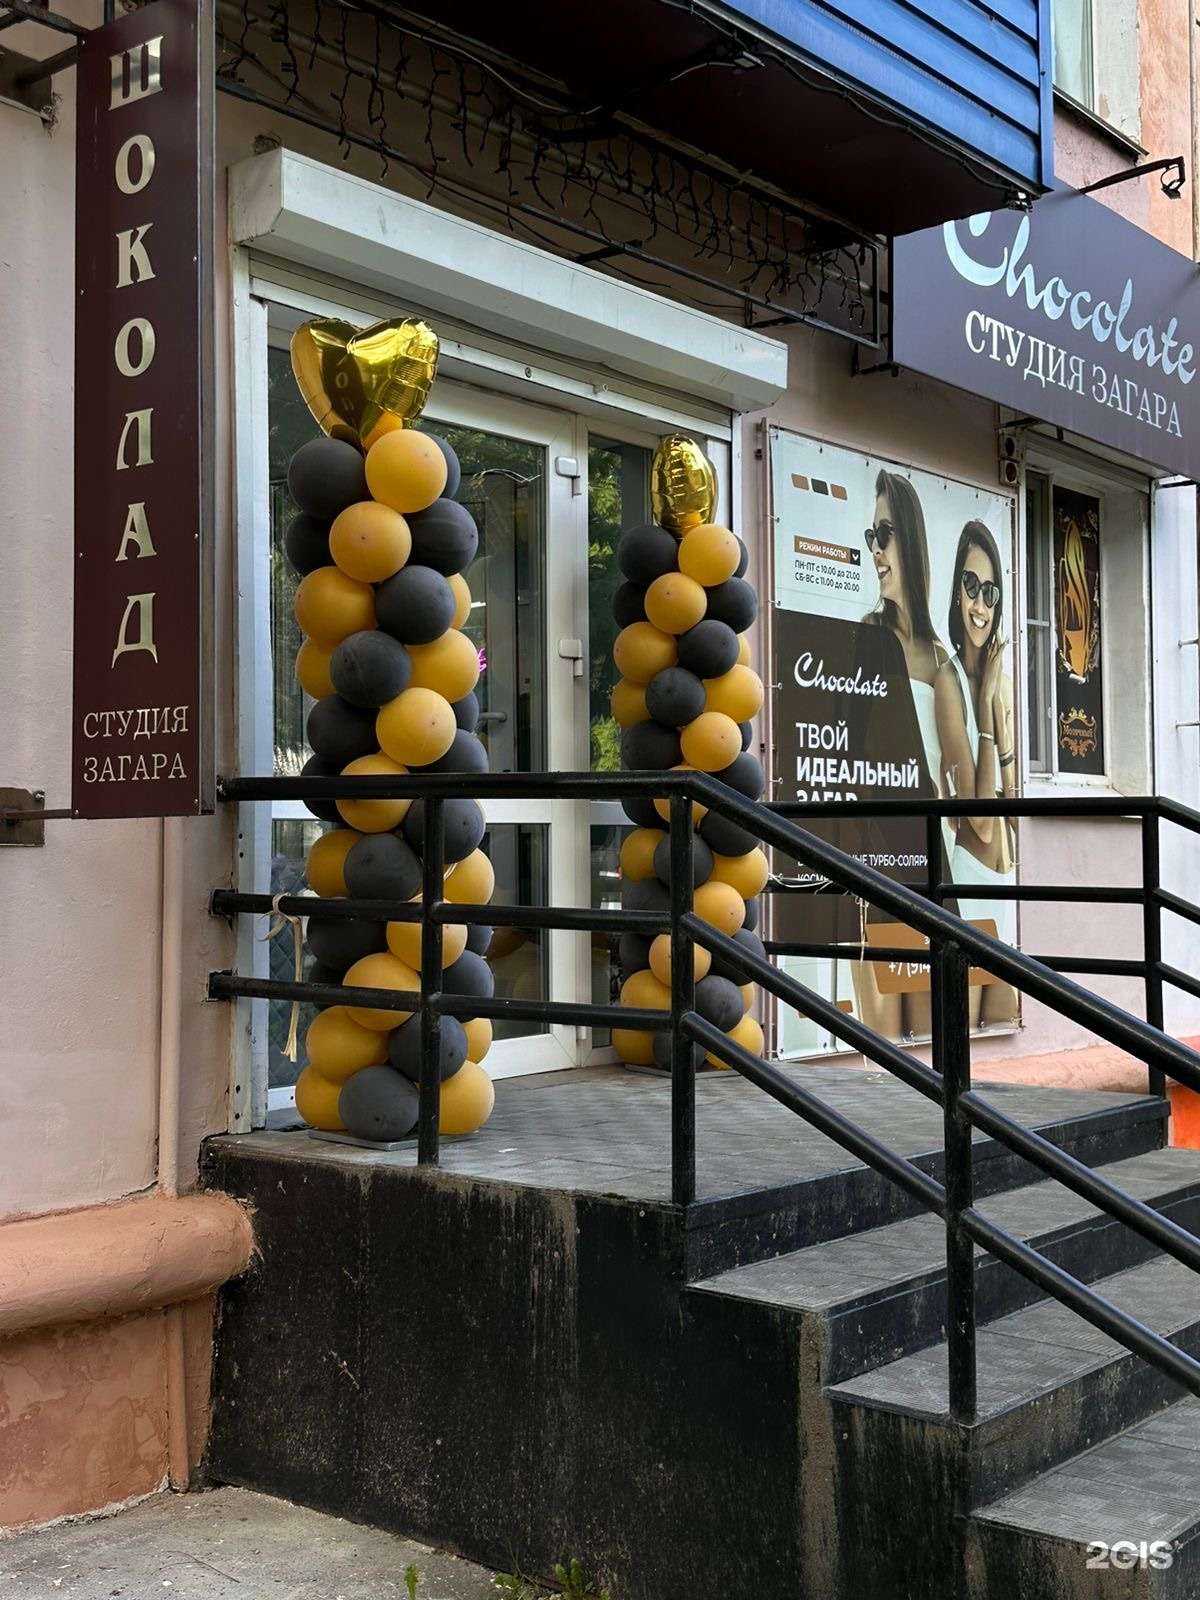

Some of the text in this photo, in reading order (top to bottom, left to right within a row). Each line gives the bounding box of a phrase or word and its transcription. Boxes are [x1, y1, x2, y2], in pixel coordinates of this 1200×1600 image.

[943, 211, 1197, 384] Chocolate
[108, 35, 165, 669] ШОКОЛАД
[964, 310, 1184, 438] СТУДИЯ ЗАГАРА
[795, 560, 815, 572] ПН-ПТ
[837, 569, 845, 578] до
[795, 572, 815, 584] СБ-ВС
[835, 581, 843, 590] до
[794, 651, 889, 698] Chocolate
[83, 706, 189, 741] СТУДИЯ
[795, 720, 849, 752] ТВОЙ
[83, 753, 187, 784] ЗАГАРА
[796, 756, 920, 789] ИДЕАЛЬНЫЙ
